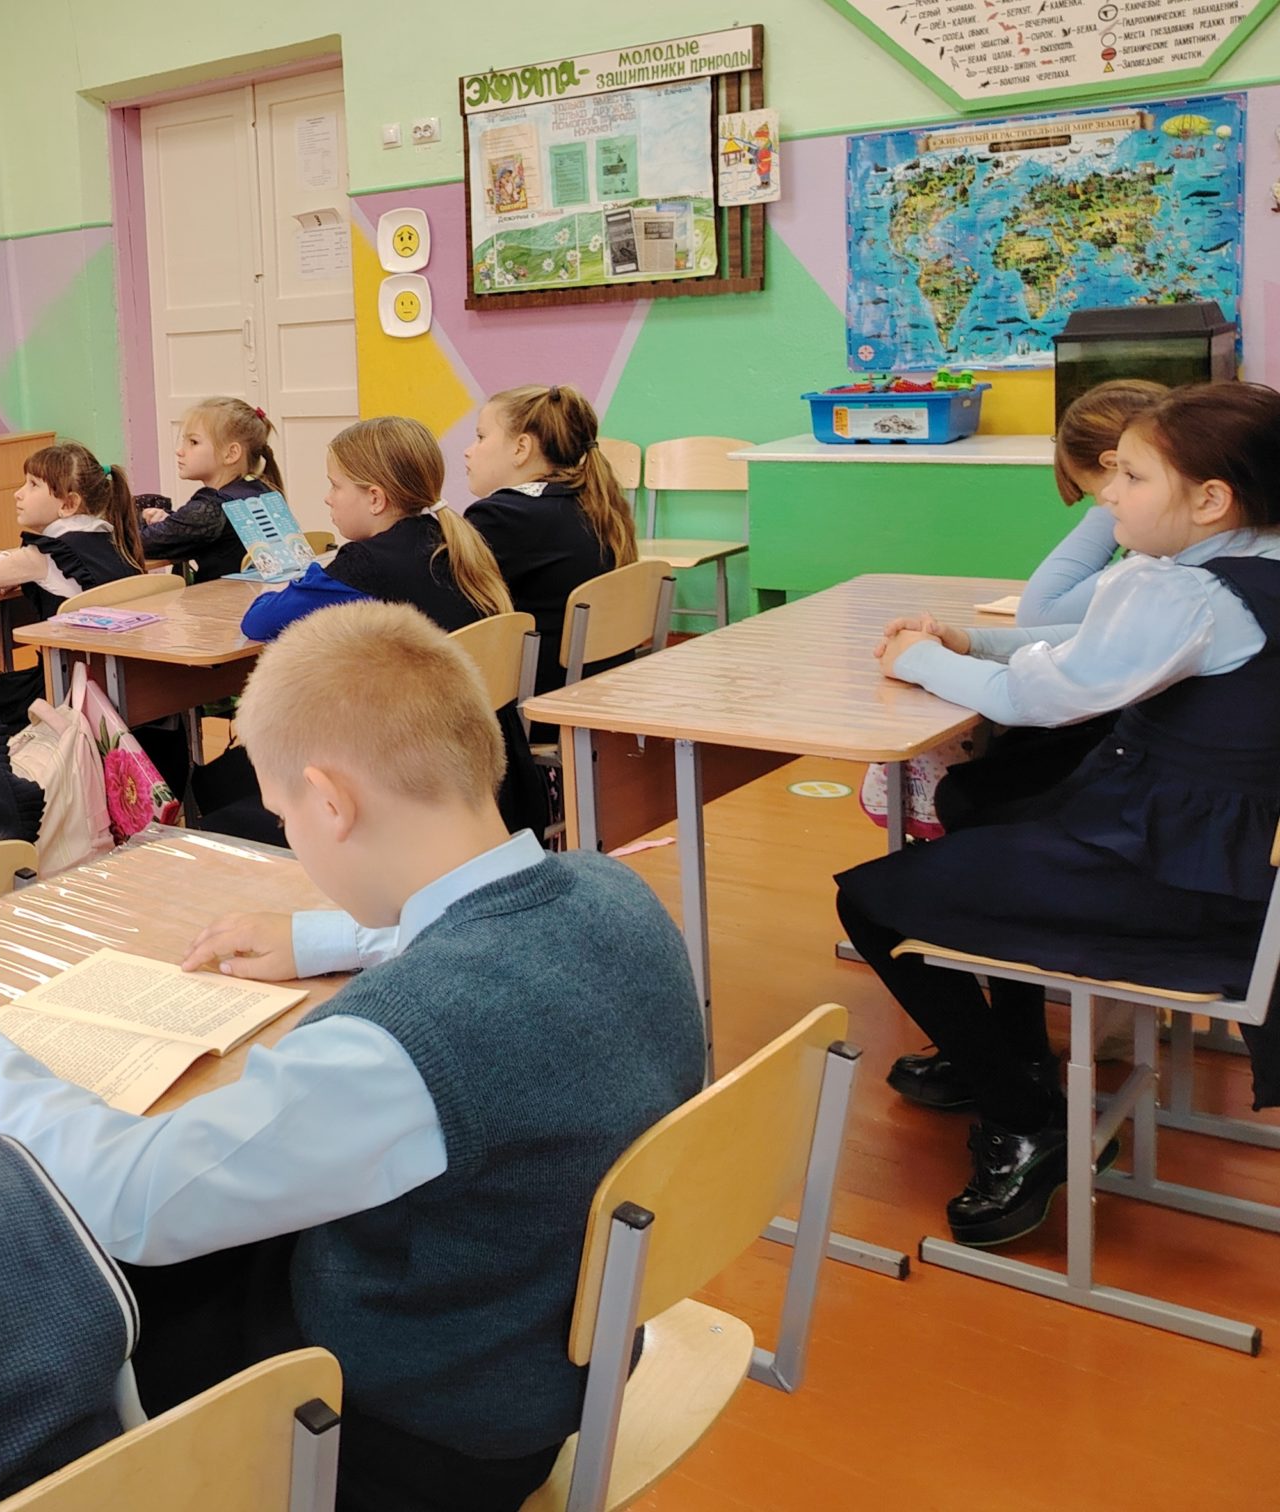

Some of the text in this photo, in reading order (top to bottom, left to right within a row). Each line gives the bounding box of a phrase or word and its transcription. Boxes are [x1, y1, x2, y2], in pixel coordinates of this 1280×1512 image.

[919, 7, 941, 19] СЕРЫЙ
[1123, 9, 1186, 27] ГИДРОХИМИЧЕСКИЕ
[1124, 30, 1145, 40] МЕСТА
[1151, 22, 1194, 37] ГНЕЗДОВАНИЯ
[1200, 17, 1225, 29] РЕДКИХ
[1122, 40, 1168, 55] БОТАНИЧЕСКИЕ
[1122, 55, 1165, 69] ЗАПОВЕДНЫЕ
[939, 132, 989, 145] ЖИВОТНЫЙ
[991, 132, 998, 140] И
[1000, 124, 1071, 139] РАСТИТЕЛЬНЫЙ
[1072, 122, 1094, 131] МИР
[1095, 119, 1129, 129] ЗЕМЛИ
